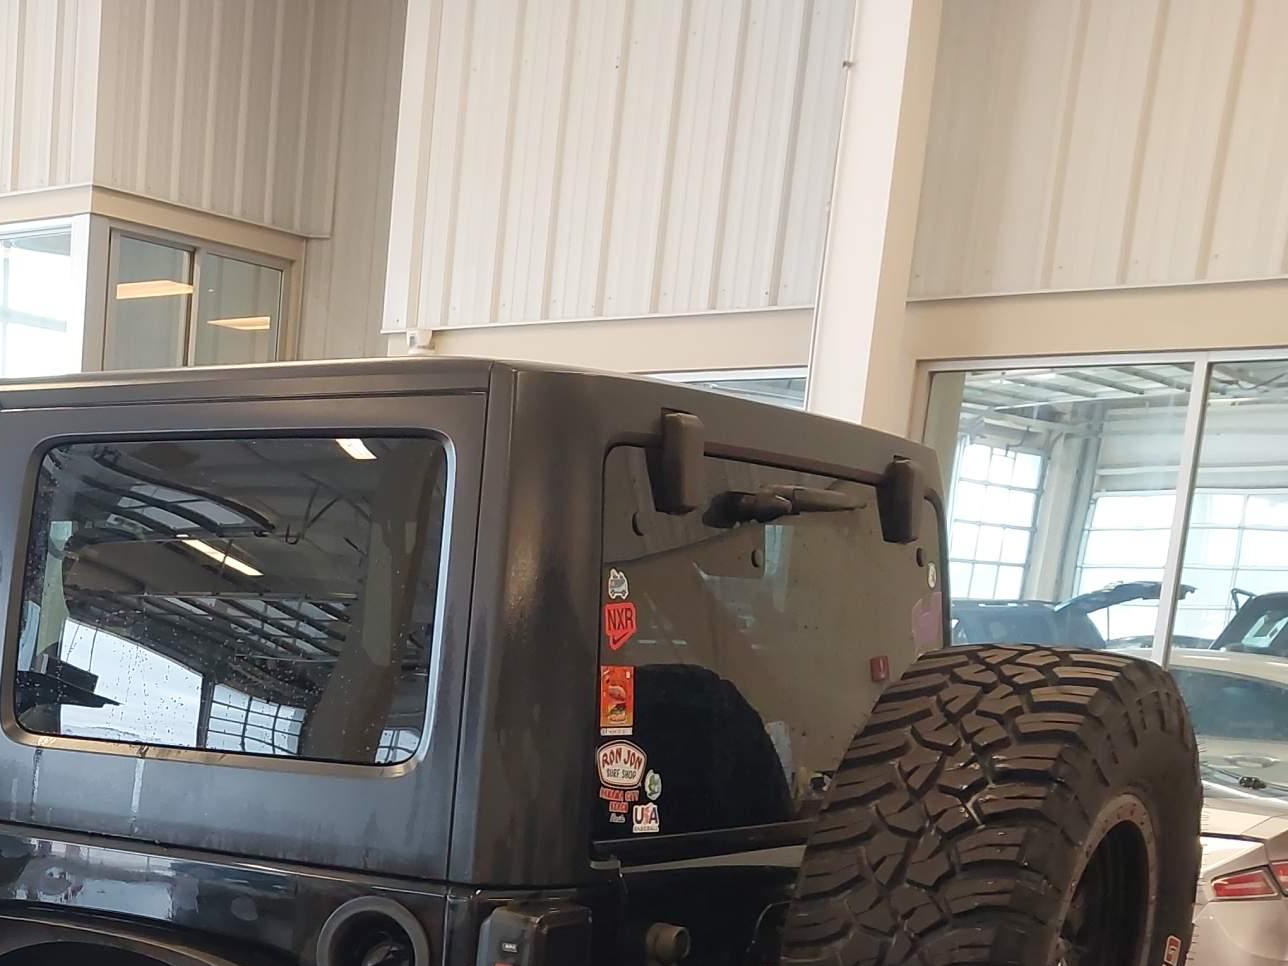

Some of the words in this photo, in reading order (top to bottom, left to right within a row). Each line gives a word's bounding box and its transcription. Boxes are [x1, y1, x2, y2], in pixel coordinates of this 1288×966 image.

[607, 607, 634, 631] NXR
[602, 747, 623, 769] RON
[623, 749, 643, 770] JON
[606, 768, 621, 778] SURF
[622, 769, 637, 780] SHOP
